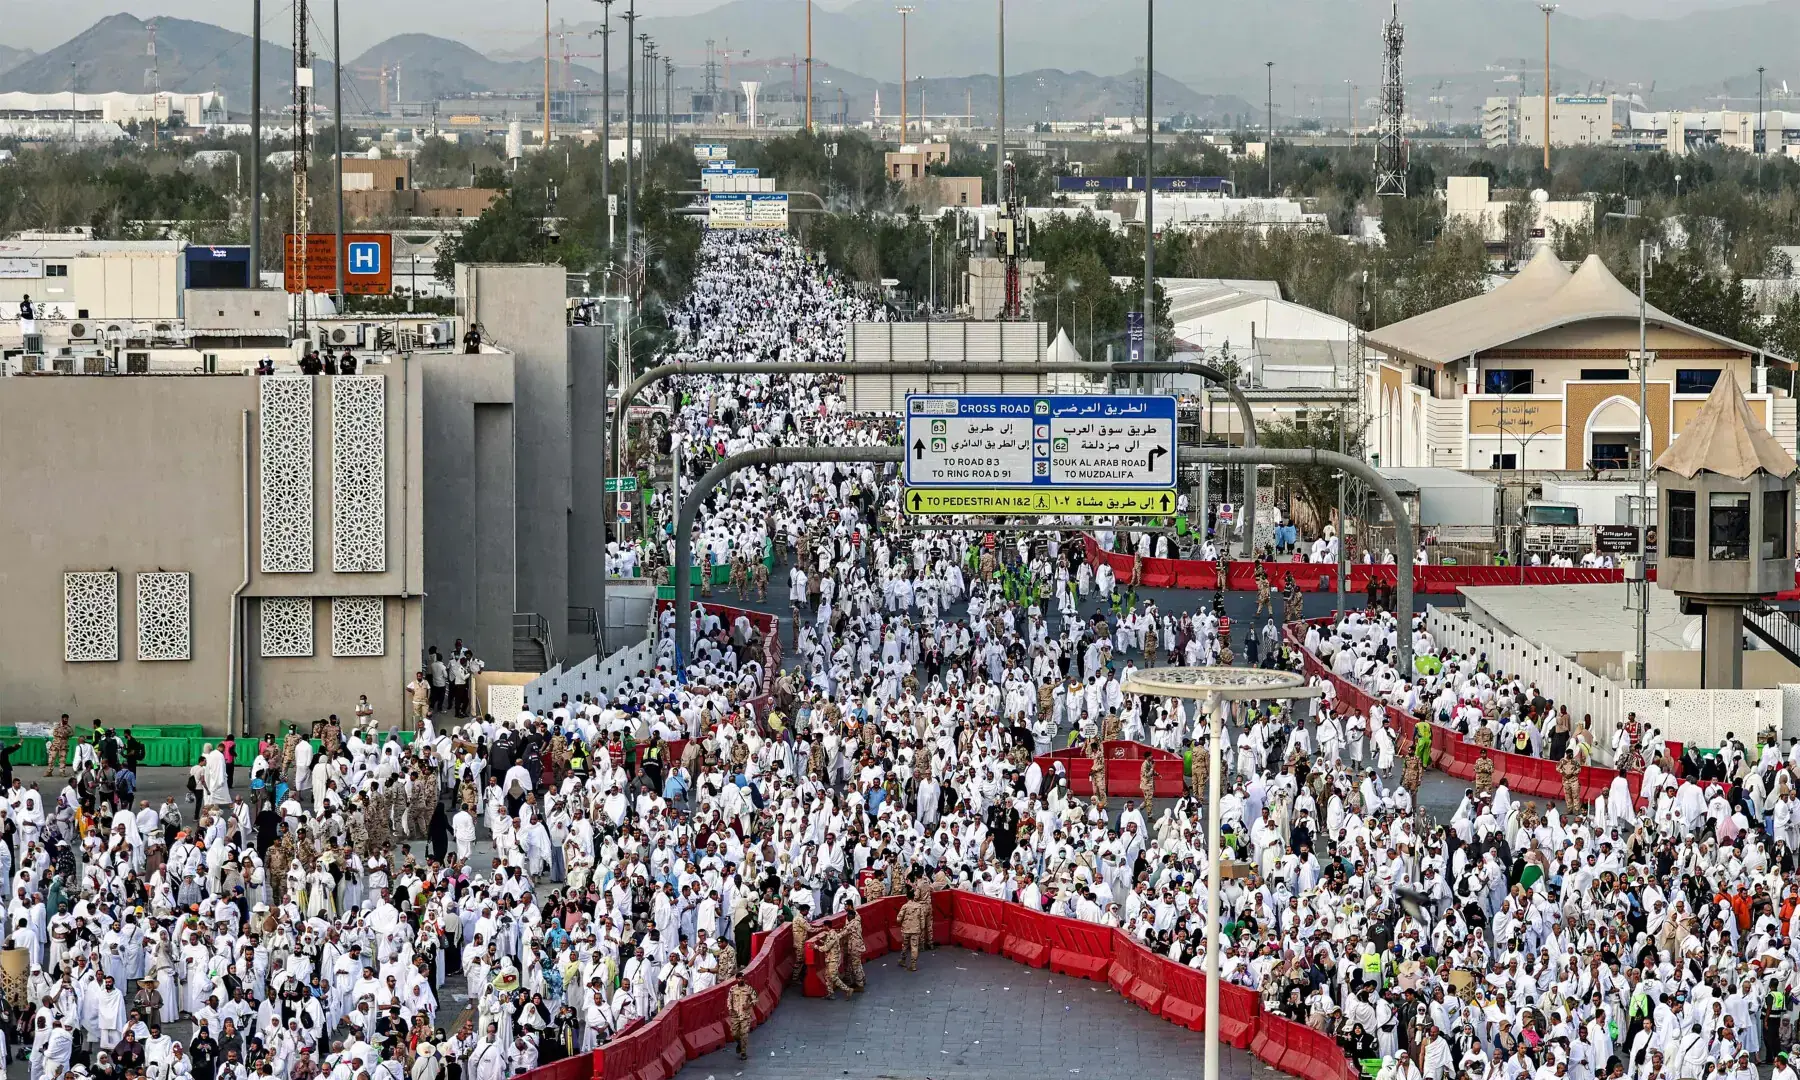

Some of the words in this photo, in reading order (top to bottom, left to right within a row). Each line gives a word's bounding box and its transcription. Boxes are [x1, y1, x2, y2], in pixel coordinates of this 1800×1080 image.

[1085, 179, 1100, 187] stc
[1172, 179, 1187, 187] stc
[356, 248, 373, 268] H
[960, 404, 997, 413] CROSS
[1000, 404, 1030, 413] ROAD
[1036, 404, 1048, 413] 79
[1052, 402, 1100, 418] العرضي
[1104, 403, 1147, 415] الطريق
[967, 424, 994, 434] طريق
[1000, 424, 1013, 434] إلى
[1063, 424, 1094, 436] العرب
[1098, 425, 1123, 436] سوق
[1127, 425, 1157, 436] طريق
[950, 439, 982, 453] الدائري
[984, 440, 1016, 450] الطريق
[1017, 440, 1030, 451] إلى
[1055, 442, 1067, 450] 62
[1081, 440, 1120, 452] مزدلفة
[943, 458, 955, 466] TO
[957, 458, 984, 466] ROAD
[986, 458, 1000, 466] 83
[1052, 459, 1077, 467] SOUK
[1079, 459, 1091, 467] AL
[1093, 459, 1119, 467] ARAB
[1121, 459, 1147, 467] ROAD
[932, 470, 944, 478] TO
[947, 470, 969, 478] RING
[972, 470, 1000, 478] ROAD
[1002, 470, 1011, 478] 91
[1065, 470, 1077, 478] TO
[1078, 470, 1134, 478] MUZDALIFA
[926, 497, 941, 506] TO
[943, 497, 1010, 506] PEDESTRIAN
[1013, 497, 1031, 506] 1&2
[1076, 496, 1104, 507] مشاة
[1106, 497, 1137, 509] طريق
[1139, 496, 1154, 509] إلى
